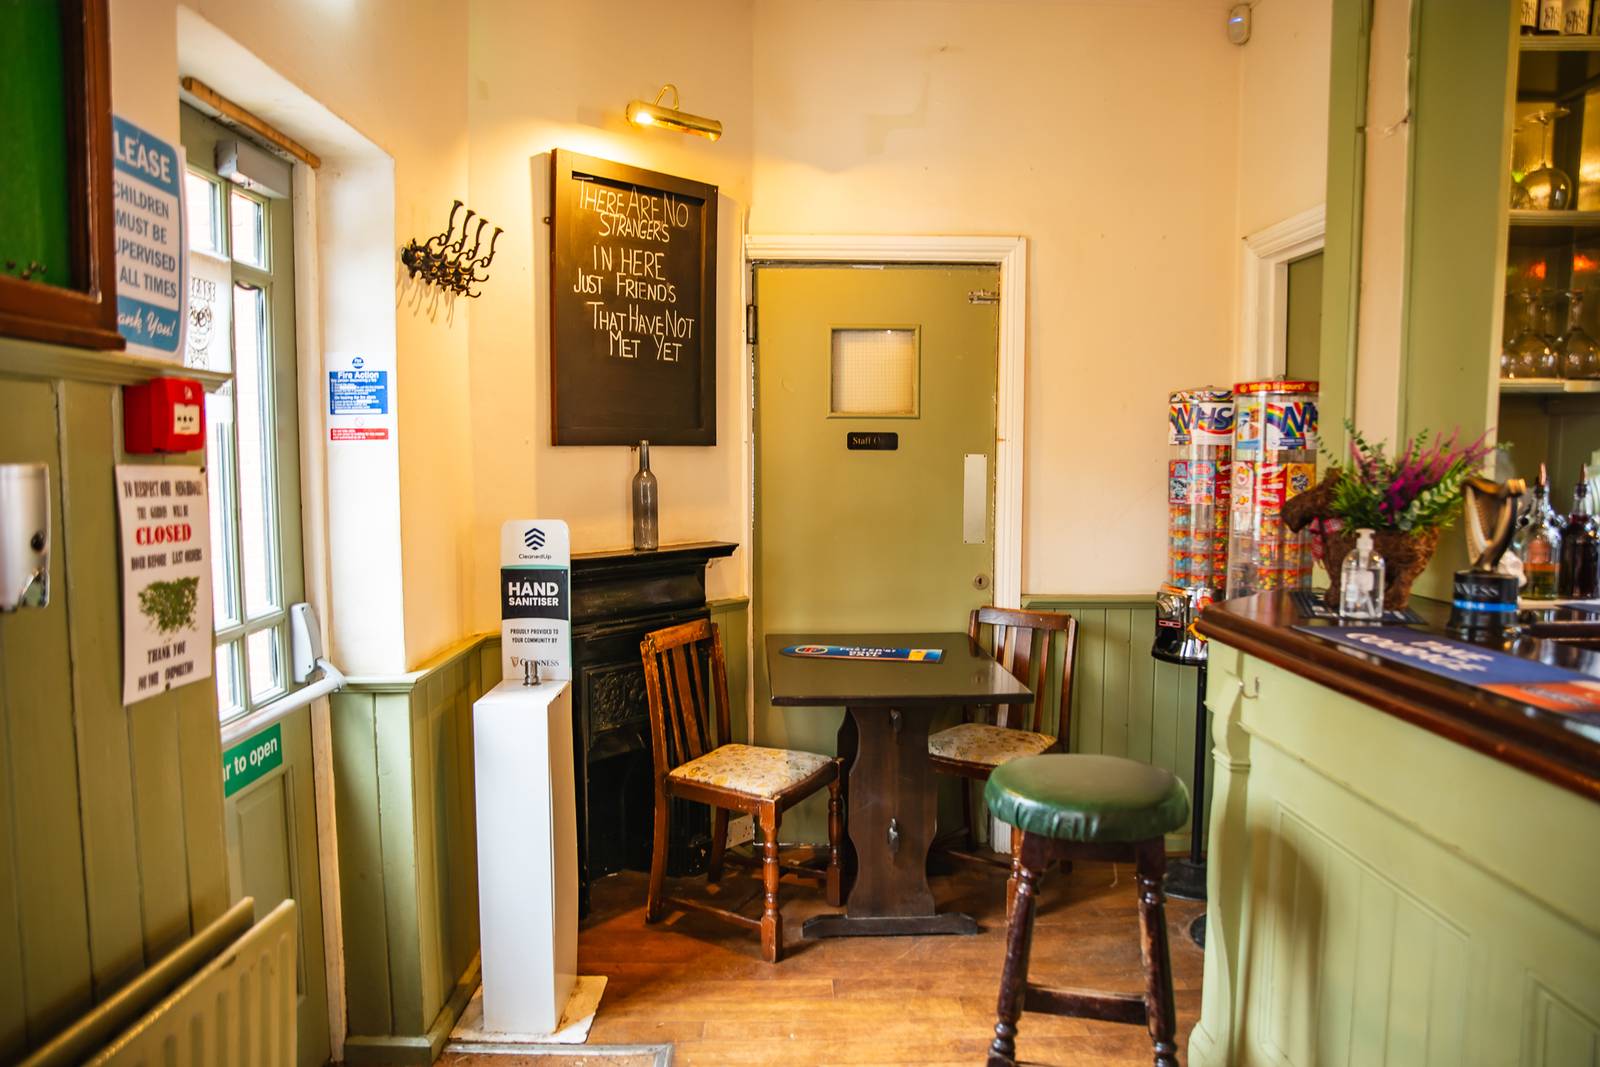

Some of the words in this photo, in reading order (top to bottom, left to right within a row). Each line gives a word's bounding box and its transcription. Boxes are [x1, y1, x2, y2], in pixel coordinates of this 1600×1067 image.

[113, 130, 171, 184] LEASE
[572, 176, 625, 217] THERE
[626, 186, 660, 221] ARE
[663, 193, 689, 228] NO
[115, 207, 149, 237] MUST
[152, 223, 167, 245] BE
[599, 212, 670, 243] STRANGERS
[593, 245, 612, 271] IN
[621, 247, 666, 281] HERE
[120, 265, 140, 288] ALL
[143, 273, 177, 299] TIMES
[574, 267, 603, 295] JUST
[616, 272, 677, 303] FRIENDS
[586, 301, 627, 331] THAT
[629, 303, 664, 336] HAVE
[665, 309, 695, 339] NOT
[609, 330, 641, 358] MET
[653, 334, 683, 362] YET
[136, 523, 192, 545] CLOSED
[508, 582, 559, 596] HAND
[508, 597, 559, 607] SANITISER
[147, 645, 171, 665] THANK
[173, 640, 186, 657] YOU
[519, 658, 560, 667] GNNESS
[233, 755, 247, 776] to
[249, 737, 278, 767] open
